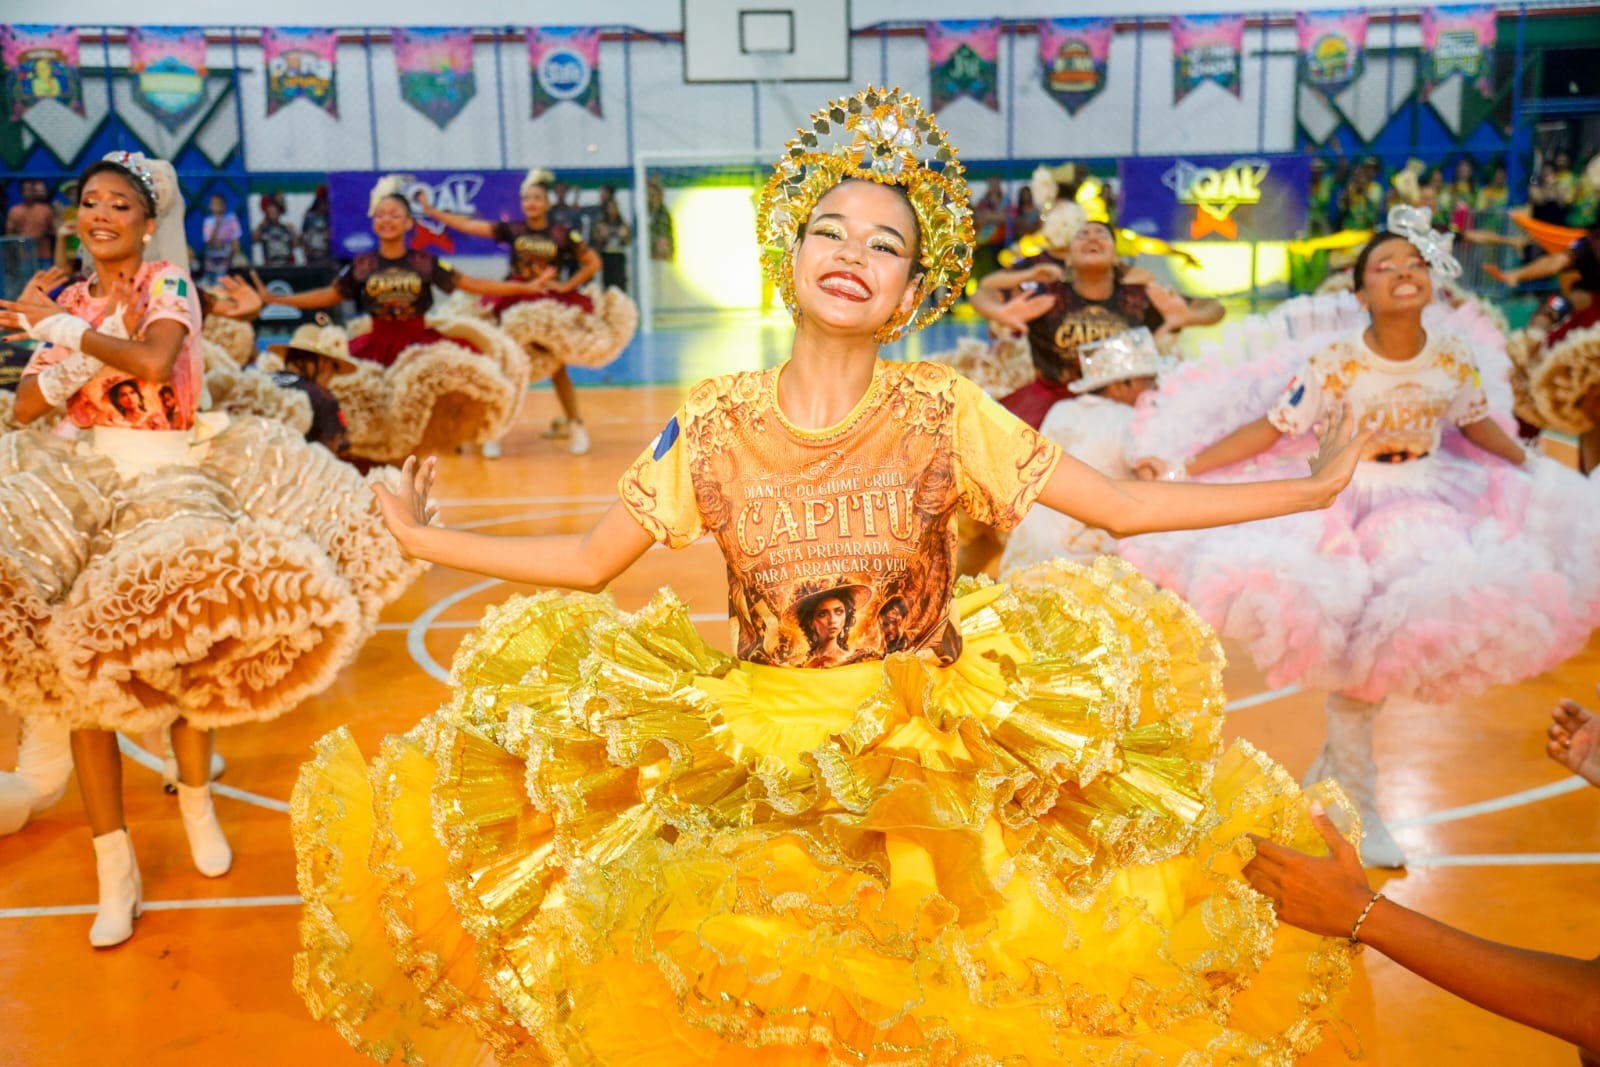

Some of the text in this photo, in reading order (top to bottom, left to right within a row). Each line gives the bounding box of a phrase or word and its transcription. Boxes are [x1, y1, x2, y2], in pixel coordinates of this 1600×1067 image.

[744, 484, 792, 499] DIANTE
[797, 483, 814, 497] DO
[864, 472, 906, 488] CRUEL
[737, 488, 916, 556] CAPITU
[769, 540, 891, 566] ESTA PREPARADA
[755, 558, 907, 585] PARA ARRANCAR O VEU
